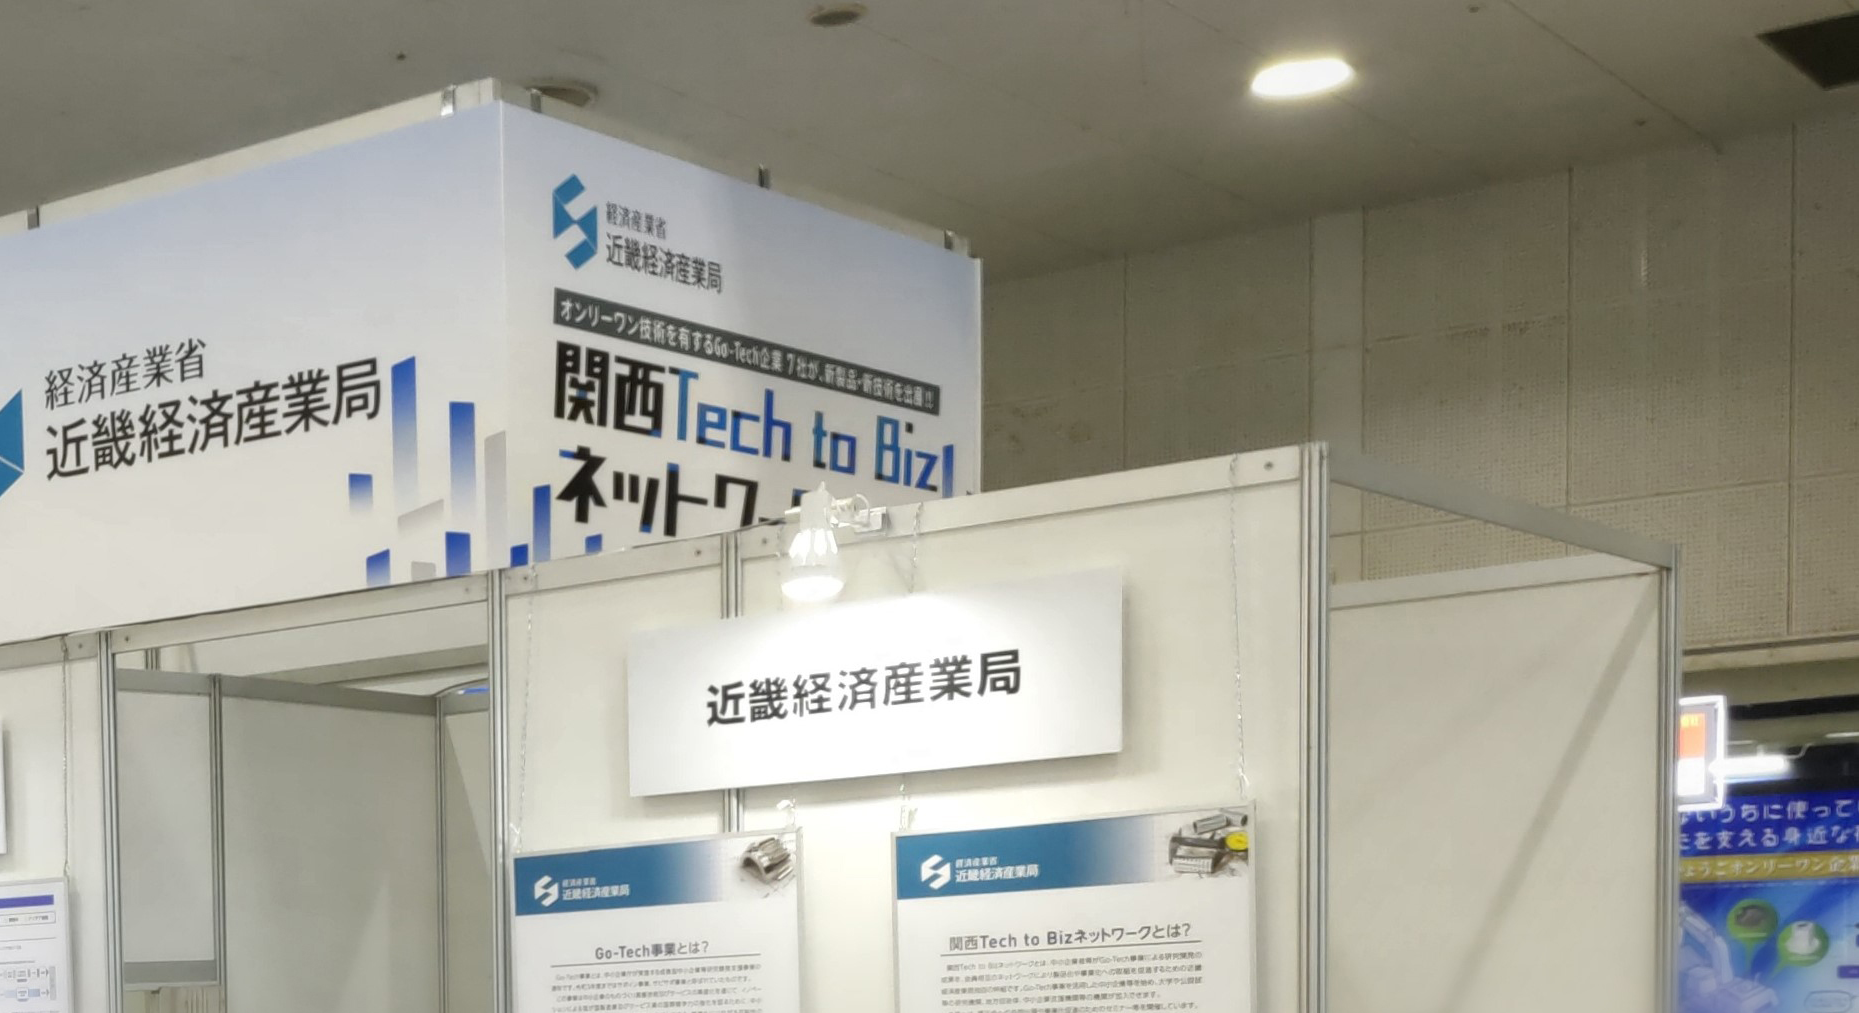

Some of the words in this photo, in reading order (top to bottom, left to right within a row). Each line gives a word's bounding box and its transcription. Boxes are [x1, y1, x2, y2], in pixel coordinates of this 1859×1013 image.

[605, 201, 668, 240] 経済産業省
[605, 234, 723, 294] 近畿経済産業局
[44, 337, 206, 410] 経済産業省
[45, 357, 383, 481] 近畿経済産業局
[554, 340, 792, 462] 関西Tech
[813, 410, 856, 475] to
[875, 415, 938, 492] Biz
[556, 445, 810, 536] ネットワー
[706, 648, 1022, 727] 近畿経済産業局
[1680, 822, 1859, 850] を支える身近な
[948, 933, 1017, 951] 関西Tech
[1024, 932, 1040, 948] to
